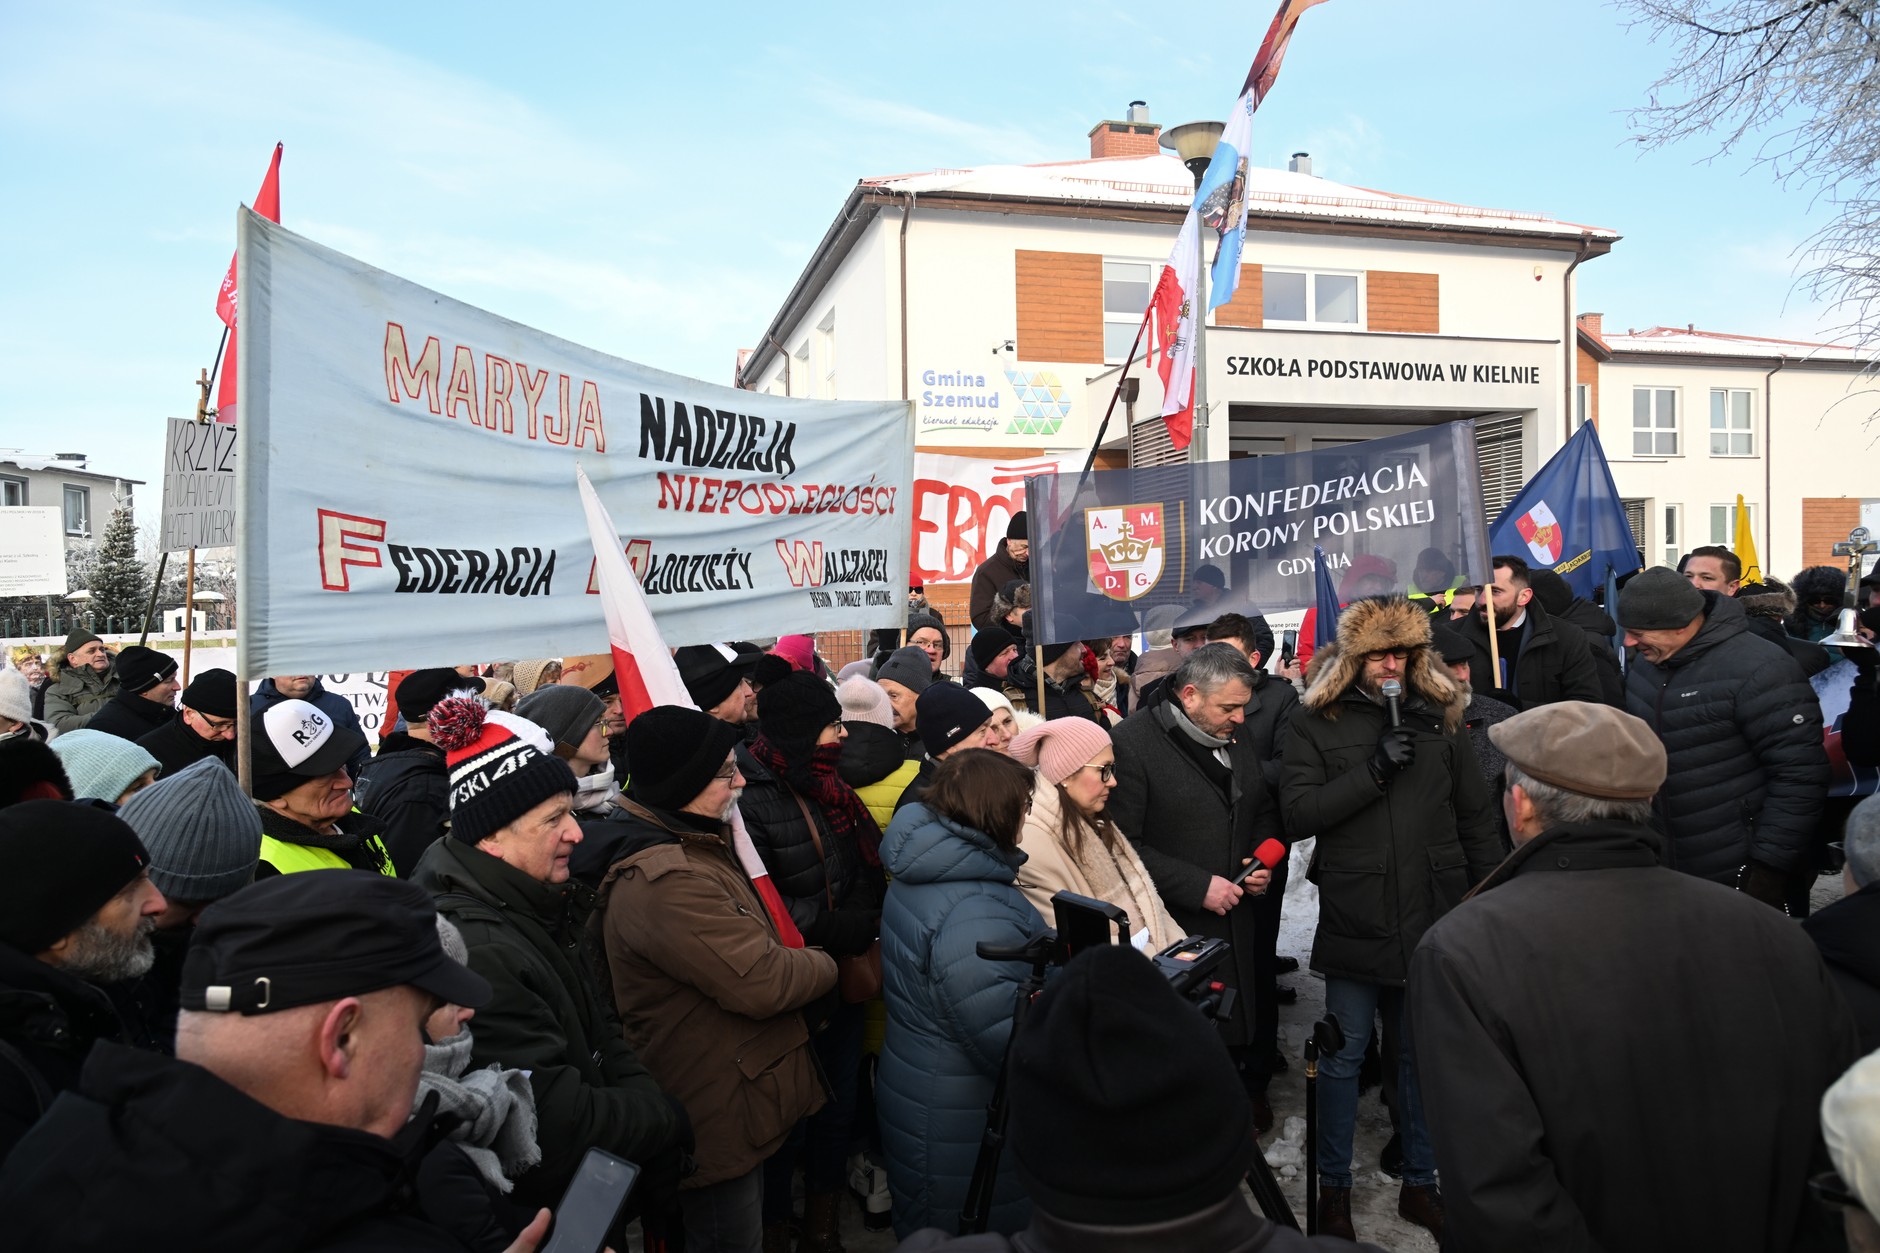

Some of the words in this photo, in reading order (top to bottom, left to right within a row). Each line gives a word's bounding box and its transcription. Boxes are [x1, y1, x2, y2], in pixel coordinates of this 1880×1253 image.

[922, 370, 985, 387] Gmina
[1227, 356, 1302, 377] SZKOŁA
[1308, 359, 1445, 382] PODSTAWOWA
[1450, 364, 1467, 382] W
[1473, 365, 1540, 384] KIELNIE
[384, 321, 605, 453] MARYJA
[922, 391, 999, 408] Szemud
[922, 415, 957, 425] kierunek
[961, 416, 999, 432] edukacja
[164, 473, 236, 508] FUNDAMENT
[657, 472, 897, 516] NIEPODLEGŁOŚCI
[1199, 462, 1429, 526] KONFEDERACJA
[200, 510, 236, 545] WIARY
[1093, 516, 1108, 530] A.
[1140, 511, 1159, 526] M.
[1199, 519, 1306, 560] KORONY
[1313, 499, 1436, 539] POLSKIEJ
[317, 508, 557, 597] FEDERACJA
[1277, 552, 1352, 576] GDYNIA
[1105, 575, 1121, 589] D.
[1135, 573, 1151, 586] G.
[809, 591, 833, 608] REGION
[835, 590, 862, 607] POMORZE
